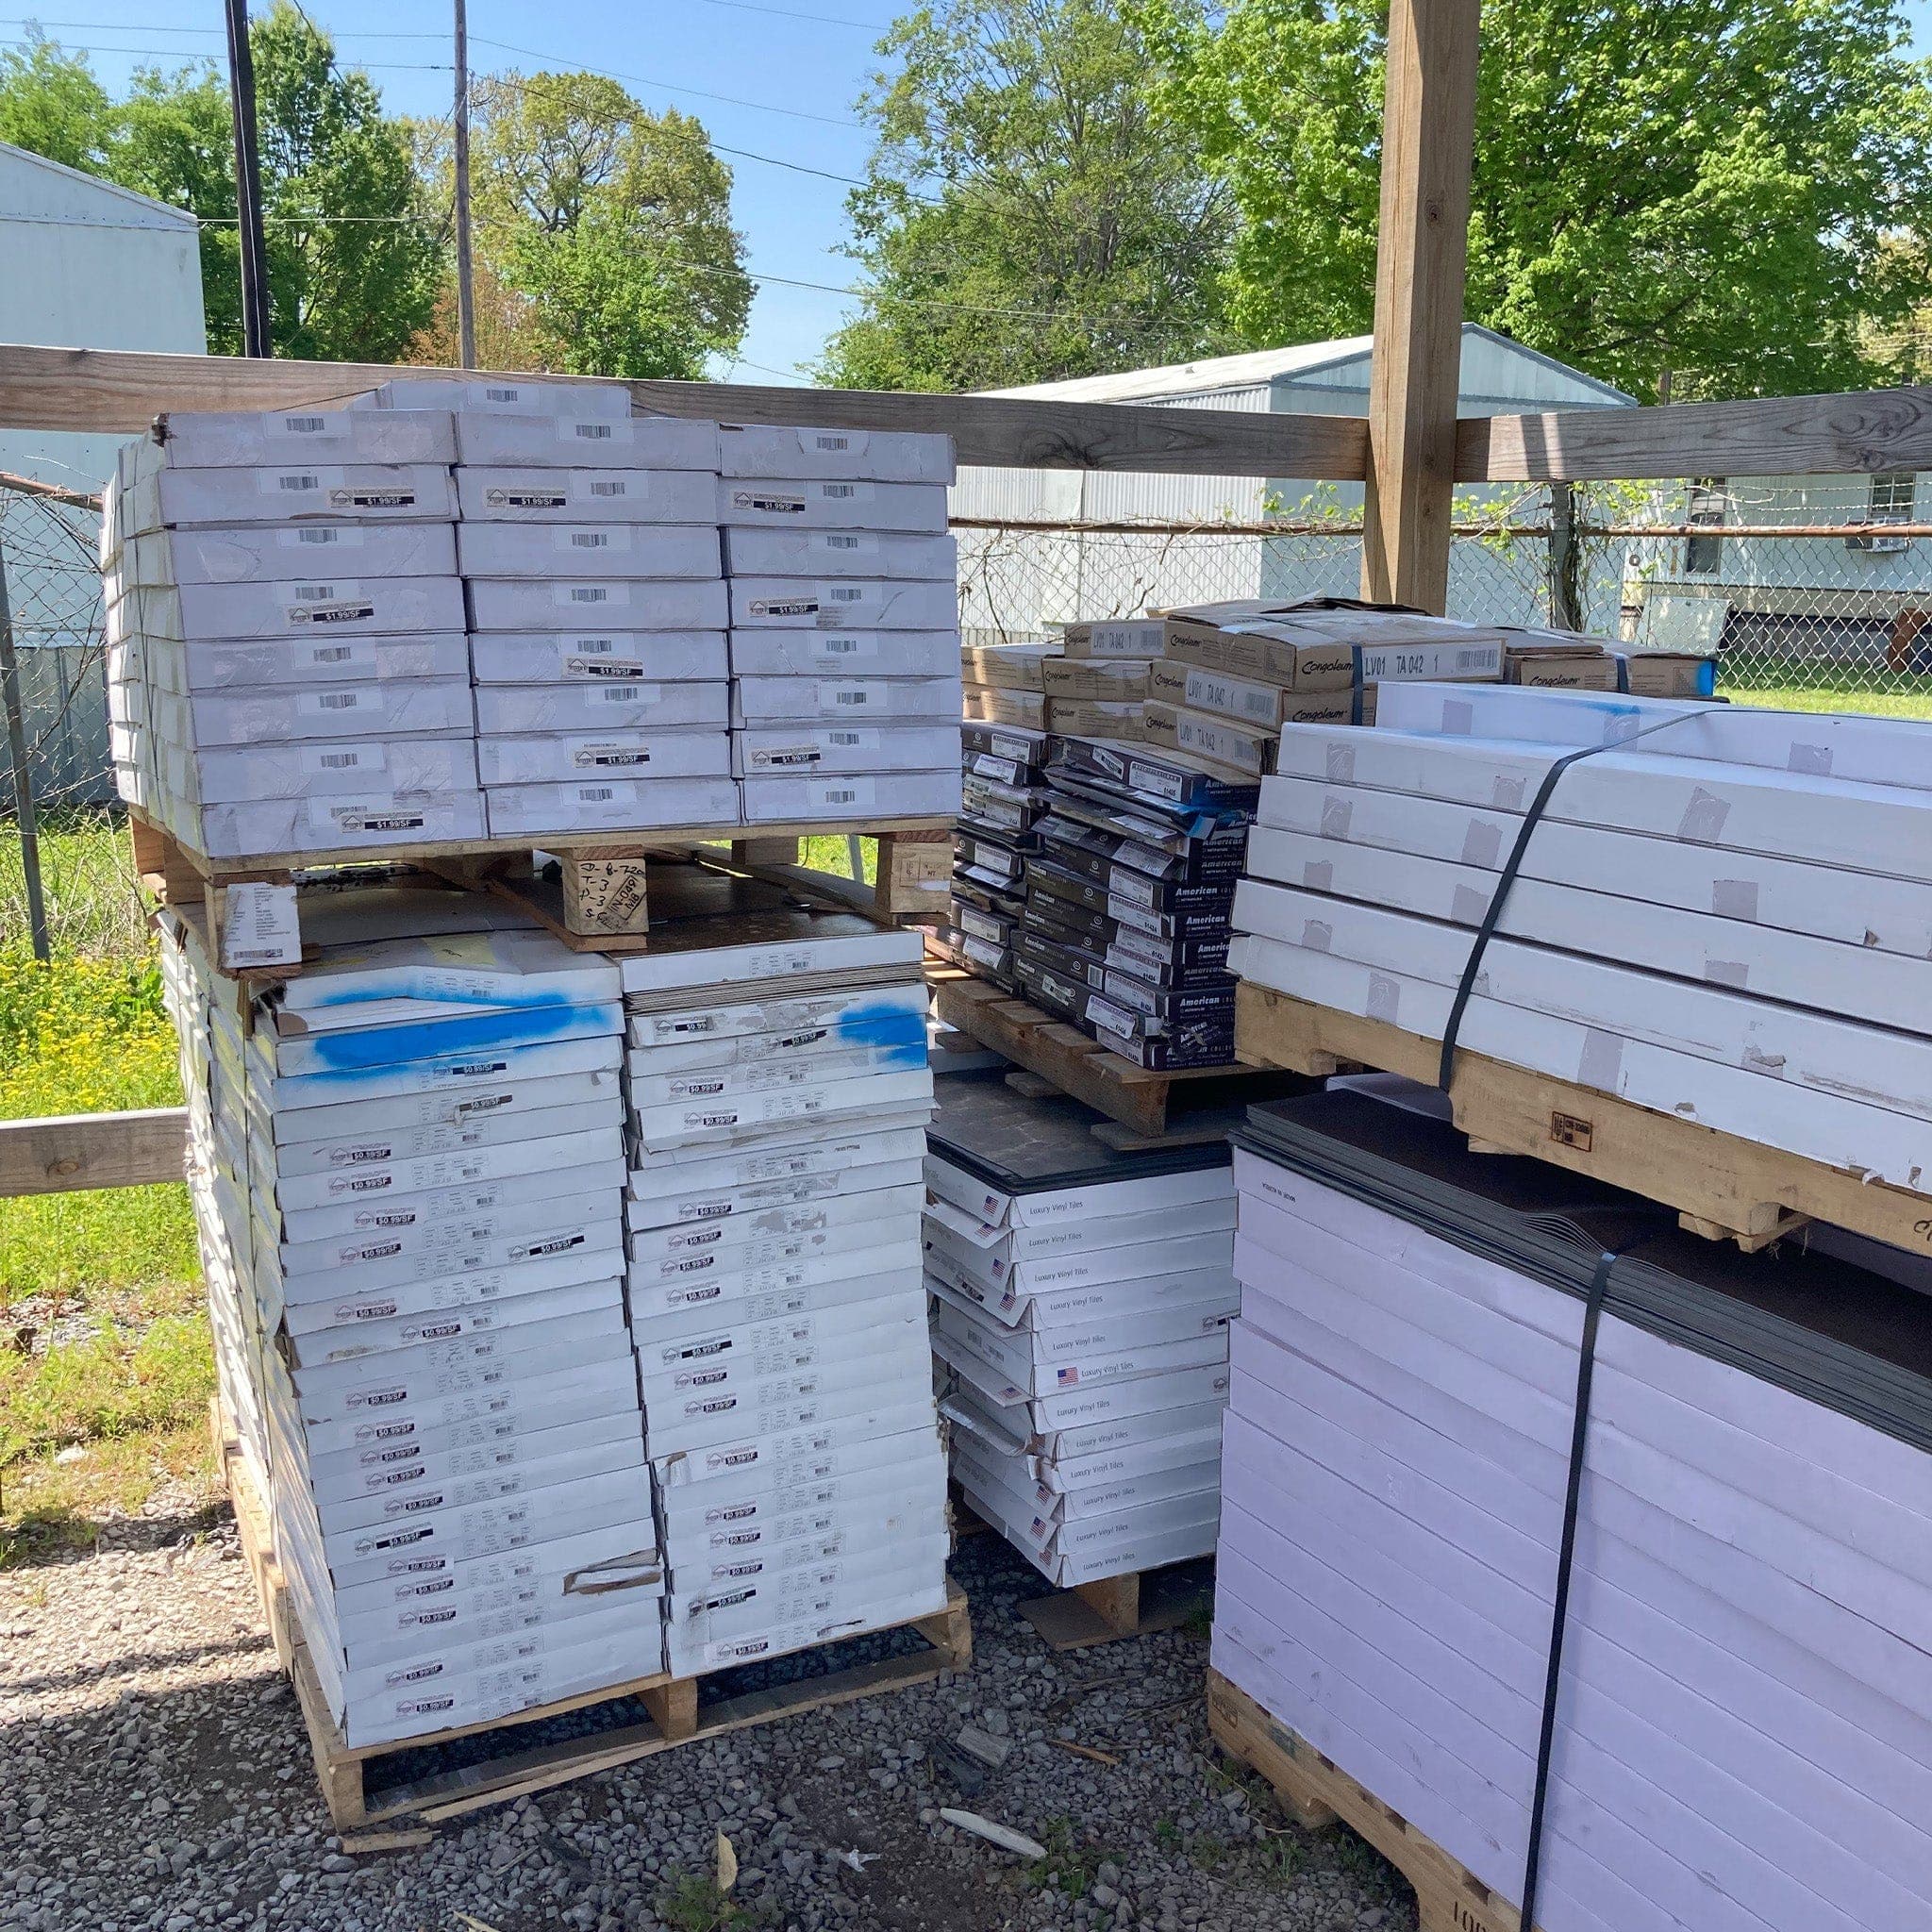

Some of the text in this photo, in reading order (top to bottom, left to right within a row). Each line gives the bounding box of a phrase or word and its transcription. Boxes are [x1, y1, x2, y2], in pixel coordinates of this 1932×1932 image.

[1365, 657, 1386, 676] LV01
[1293, 708, 1344, 723] Congoleum
[1175, 886, 1218, 896] American
[1186, 914, 1225, 924] American
[1198, 942, 1230, 953] America
[1179, 996, 1220, 1007] American
[1030, 1206, 1051, 1215] Luxury
[1053, 1203, 1067, 1213] Vinyl
[1029, 1232, 1082, 1247] Luxury Vinyl Tiles
[1035, 1267, 1089, 1282] Luxury Vinyl Tiles
[1050, 1295, 1103, 1310] Luxury Vinyl Tiles
[1053, 1335, 1106, 1351] Luxury Vinyl Tiles
[1081, 1368, 1103, 1377] Luxury
[1104, 1364, 1119, 1374] Vinyl
[1058, 1400, 1109, 1416] Luxury Vinyl Tiles
[1076, 1431, 1128, 1448] Luxury Vinyl Tiles
[1071, 1461, 1124, 1478] Luxury Vinyl Tiles
[1083, 1488, 1135, 1505] Luxury Vinyl Tiles
[1076, 1524, 1128, 1541] Luxury Vinyl Tiles
[1083, 1553, 1135, 1570] Luxury Vinyl Tiles
